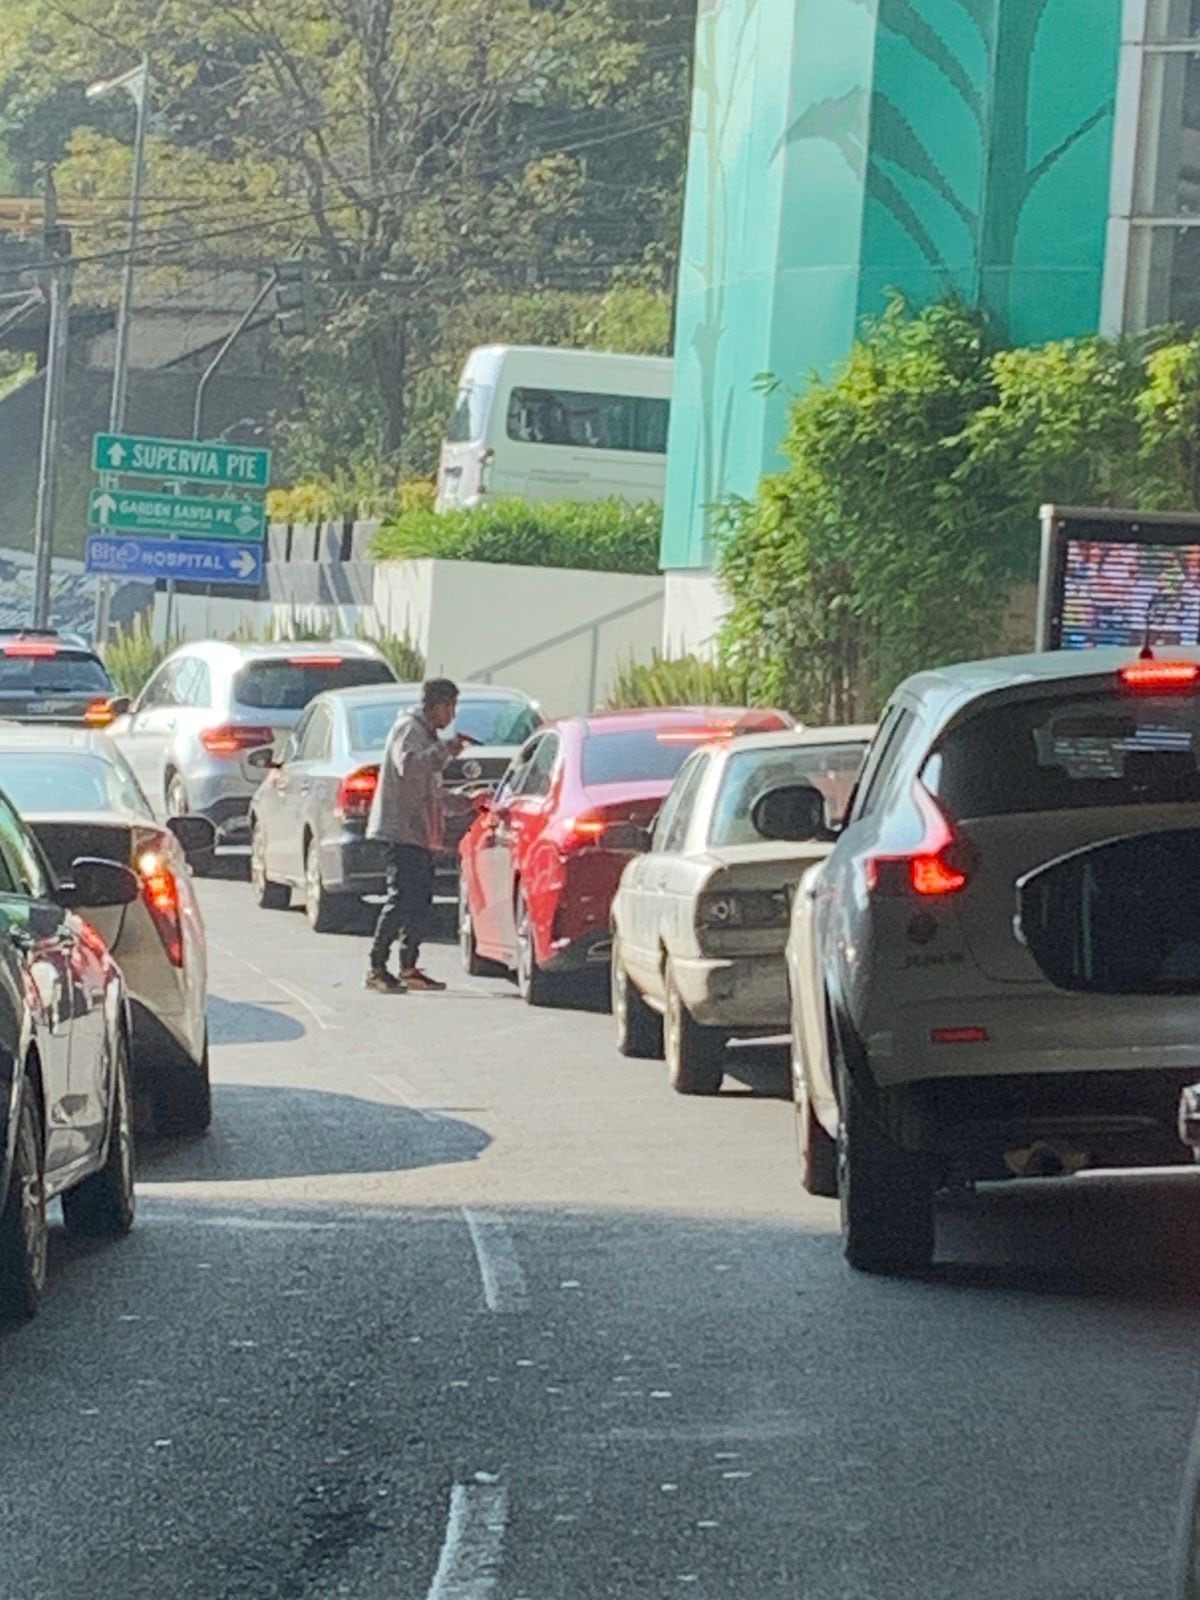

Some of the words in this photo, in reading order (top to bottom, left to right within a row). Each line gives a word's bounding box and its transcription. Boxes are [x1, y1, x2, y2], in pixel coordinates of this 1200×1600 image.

[131, 443, 219, 475] SUPERVIA
[226, 454, 257, 479] PTE
[142, 550, 224, 570] HOSPITAL
